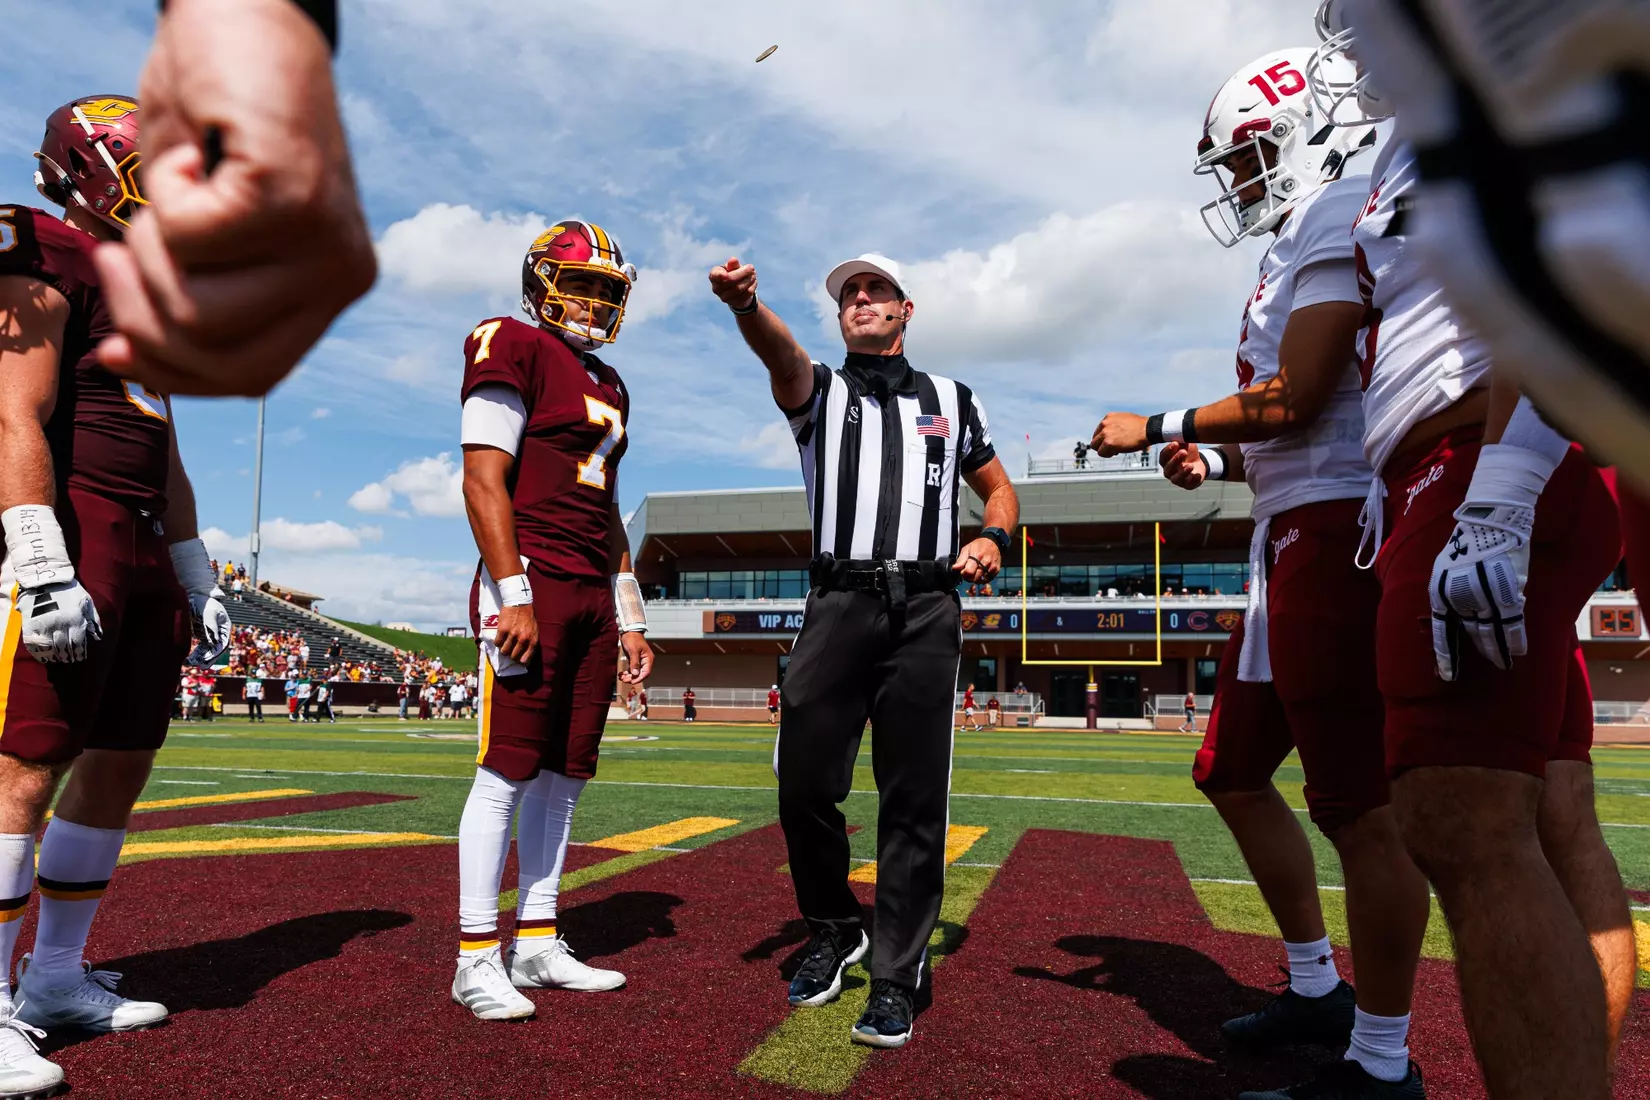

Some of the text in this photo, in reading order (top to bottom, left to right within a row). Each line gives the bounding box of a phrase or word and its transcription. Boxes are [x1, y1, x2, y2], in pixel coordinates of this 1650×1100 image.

[1248, 60, 1306, 106] 15
[472, 320, 502, 365] 7
[576, 393, 625, 491] 7
[926, 462, 941, 487] R
[20, 508, 57, 581] John 13:14
[759, 614, 781, 628] VIP
[1010, 614, 1018, 628] 0
[1056, 616, 1064, 626] &
[1097, 613, 1125, 628] 2:01
[1170, 613, 1179, 628] 0
[1600, 609, 1634, 632] 25
